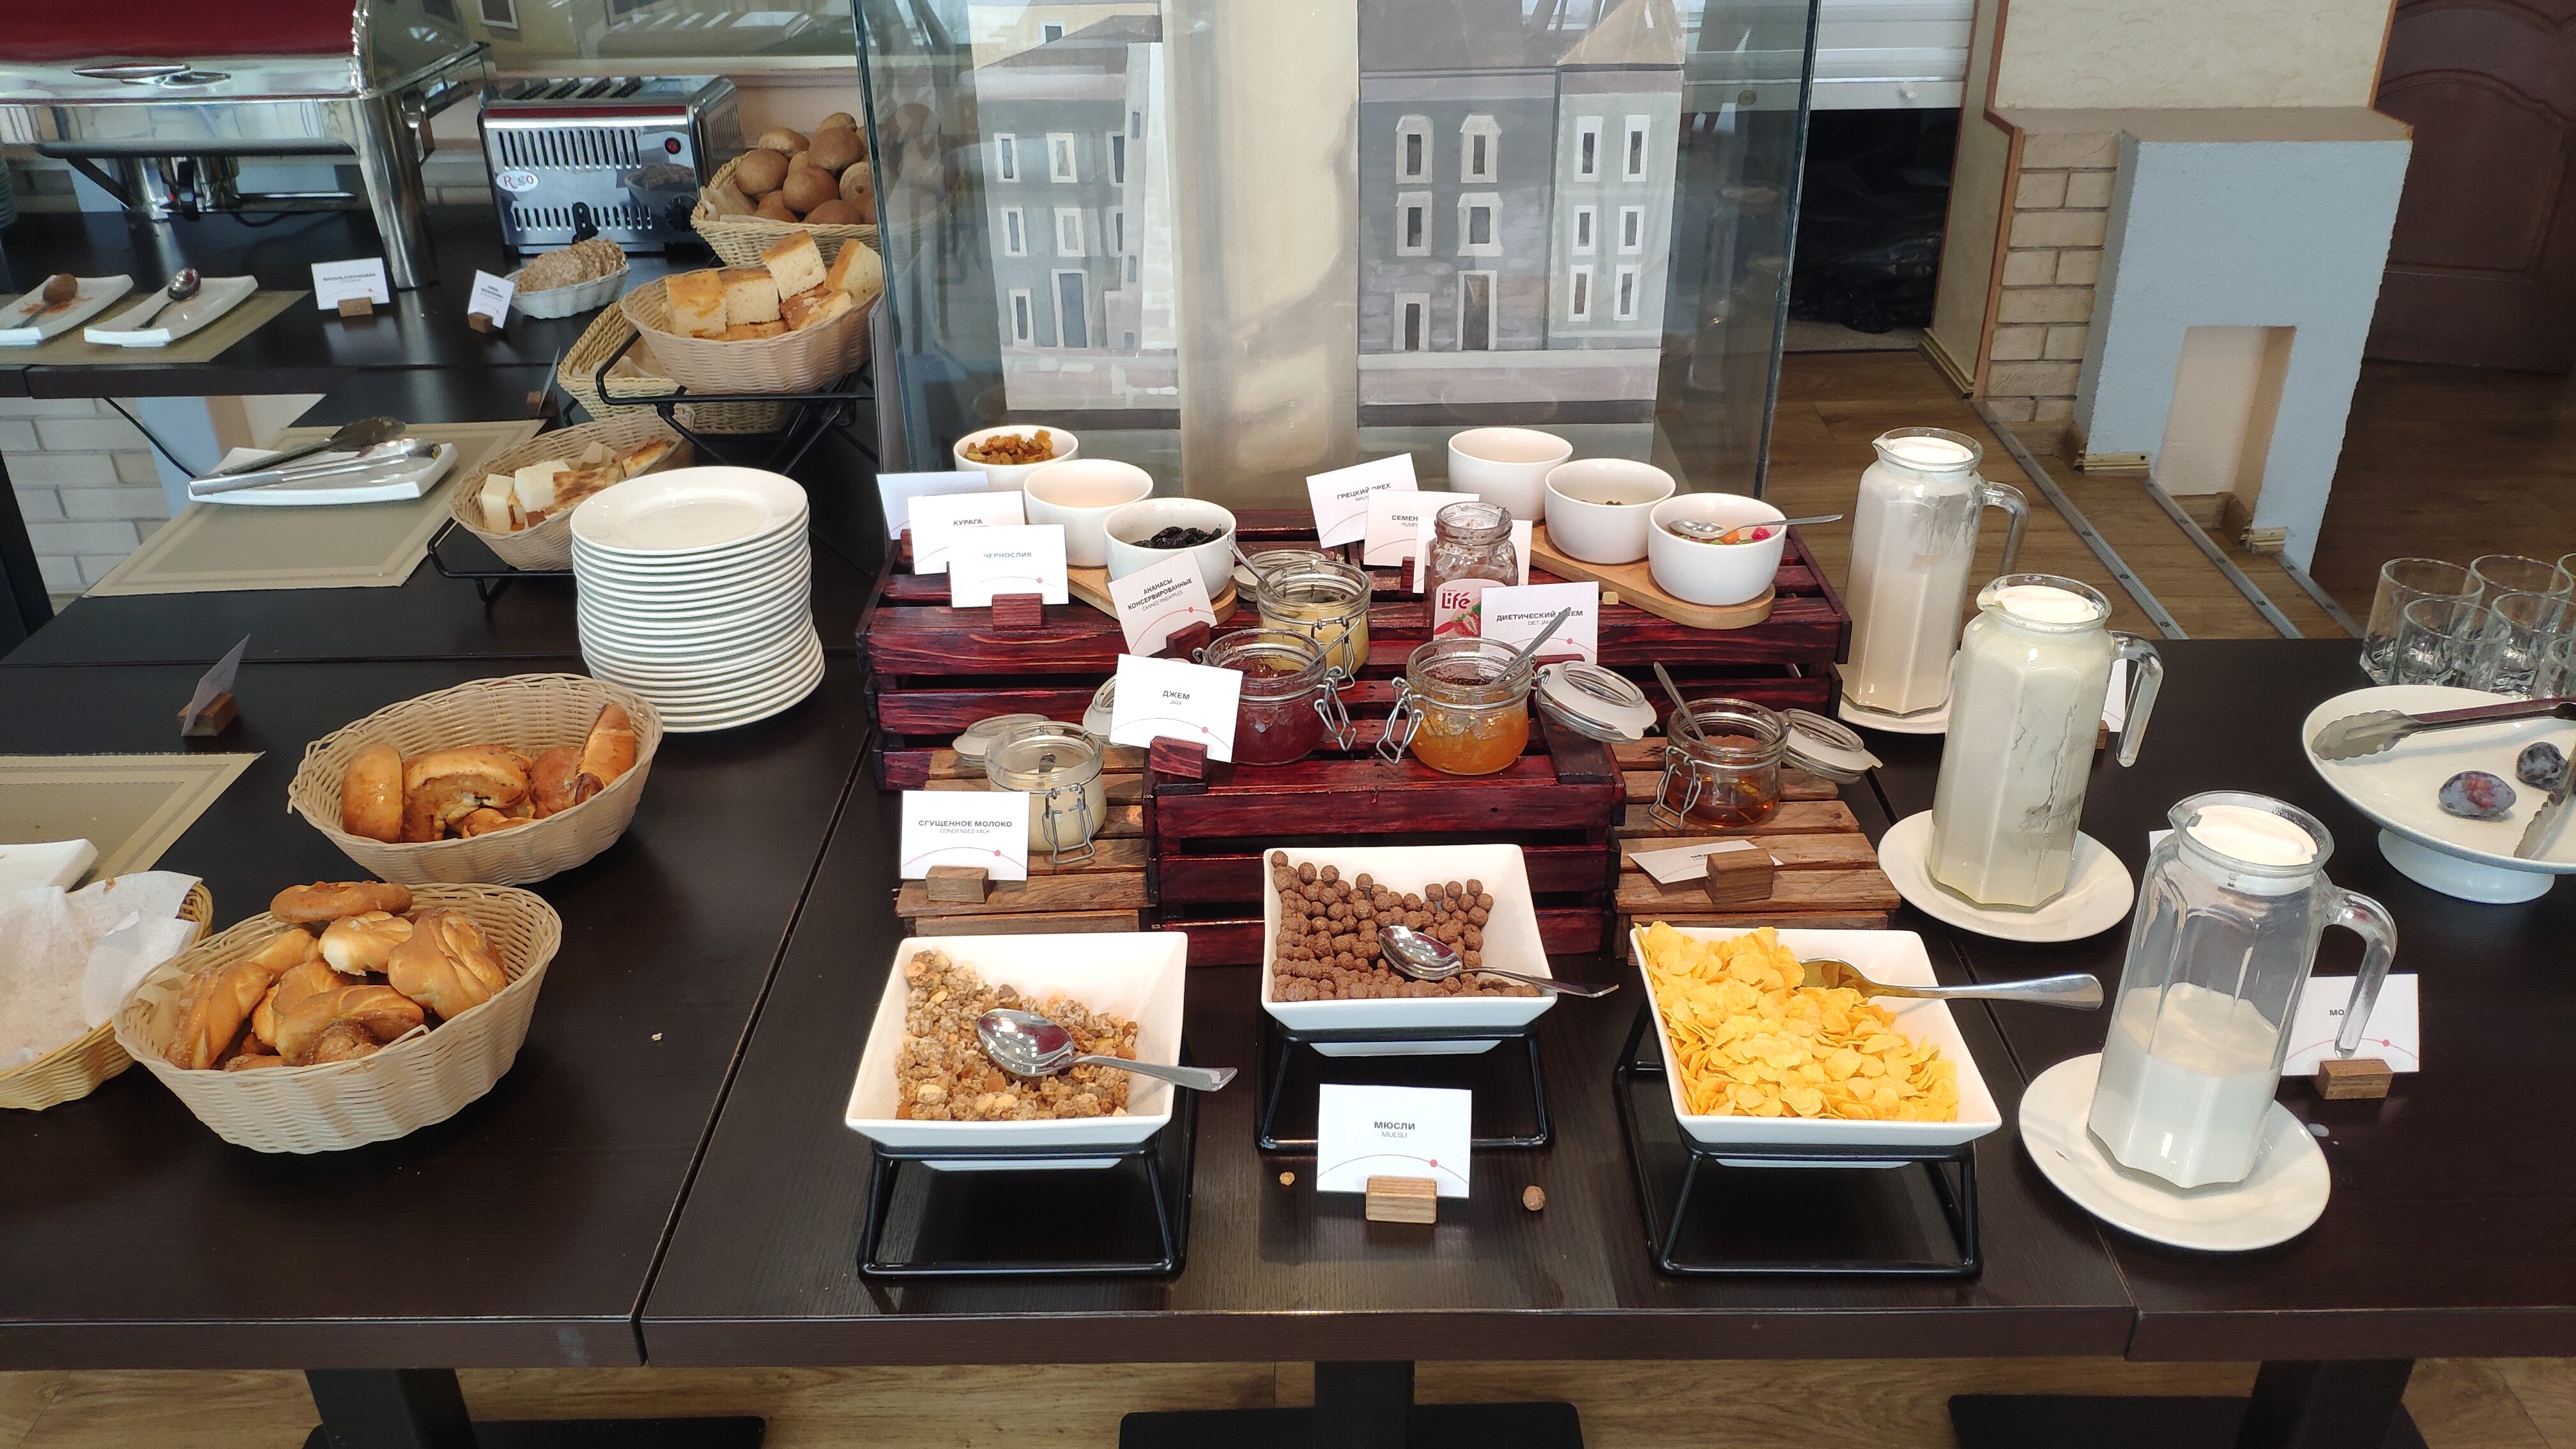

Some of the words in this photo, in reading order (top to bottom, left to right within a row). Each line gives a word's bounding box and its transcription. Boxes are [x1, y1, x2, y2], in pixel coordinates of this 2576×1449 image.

[1337, 487, 1370, 500] ГРЕЦКИЙ
[1144, 578, 1173, 595] АНАНАСЫ
[1128, 578, 1193, 611] КОНСЕРВИРОВАННЫЕ
[1142, 600, 1160, 611] CANNED
[1159, 590, 1183, 603] PINEAPPLES
[1496, 611, 1556, 622] ДИЕТИЧЕСКИЙ
[1163, 691, 1190, 700] ДЖЕМ
[1374, 1121, 1415, 1130] МЮСЛИ
